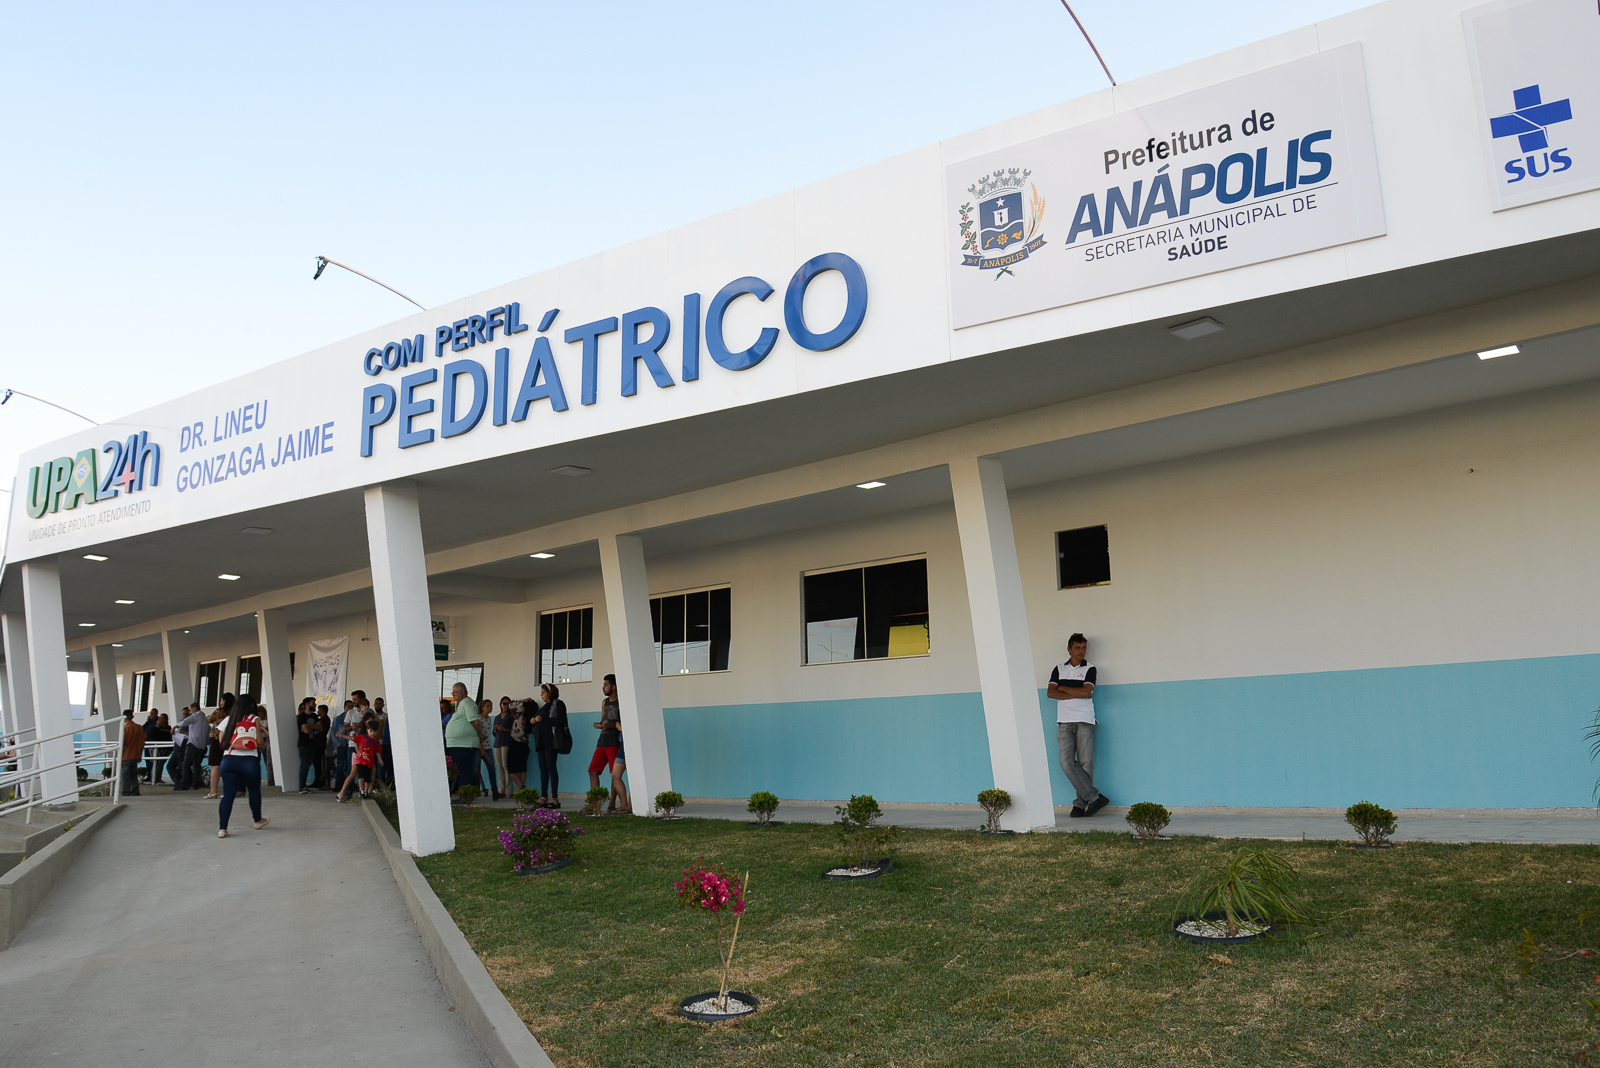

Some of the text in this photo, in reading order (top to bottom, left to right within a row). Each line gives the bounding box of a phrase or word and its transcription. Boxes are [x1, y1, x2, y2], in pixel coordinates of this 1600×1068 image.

[1103, 109, 1276, 175] Prefeitura de
[1504, 147, 1573, 184] SUS
[1065, 129, 1333, 245] ANÁPOLIS
[983, 251, 1025, 268] ANÁPOLIS
[1084, 193, 1318, 262] SECRETARIA MUNICIPAL DE
[1167, 234, 1228, 262] SAÚDE
[359, 251, 869, 459] PEDIÁTRICO
[363, 302, 529, 377] COM PERFIL
[176, 421, 335, 493] GONZAGA JAIME
[180, 399, 268, 454] DR. LINEU
[26, 448, 98, 519] UPA
[28, 499, 151, 542] UNIDADE DE PRONTO ATENDIMENTO
[431, 620, 446, 632] PA
